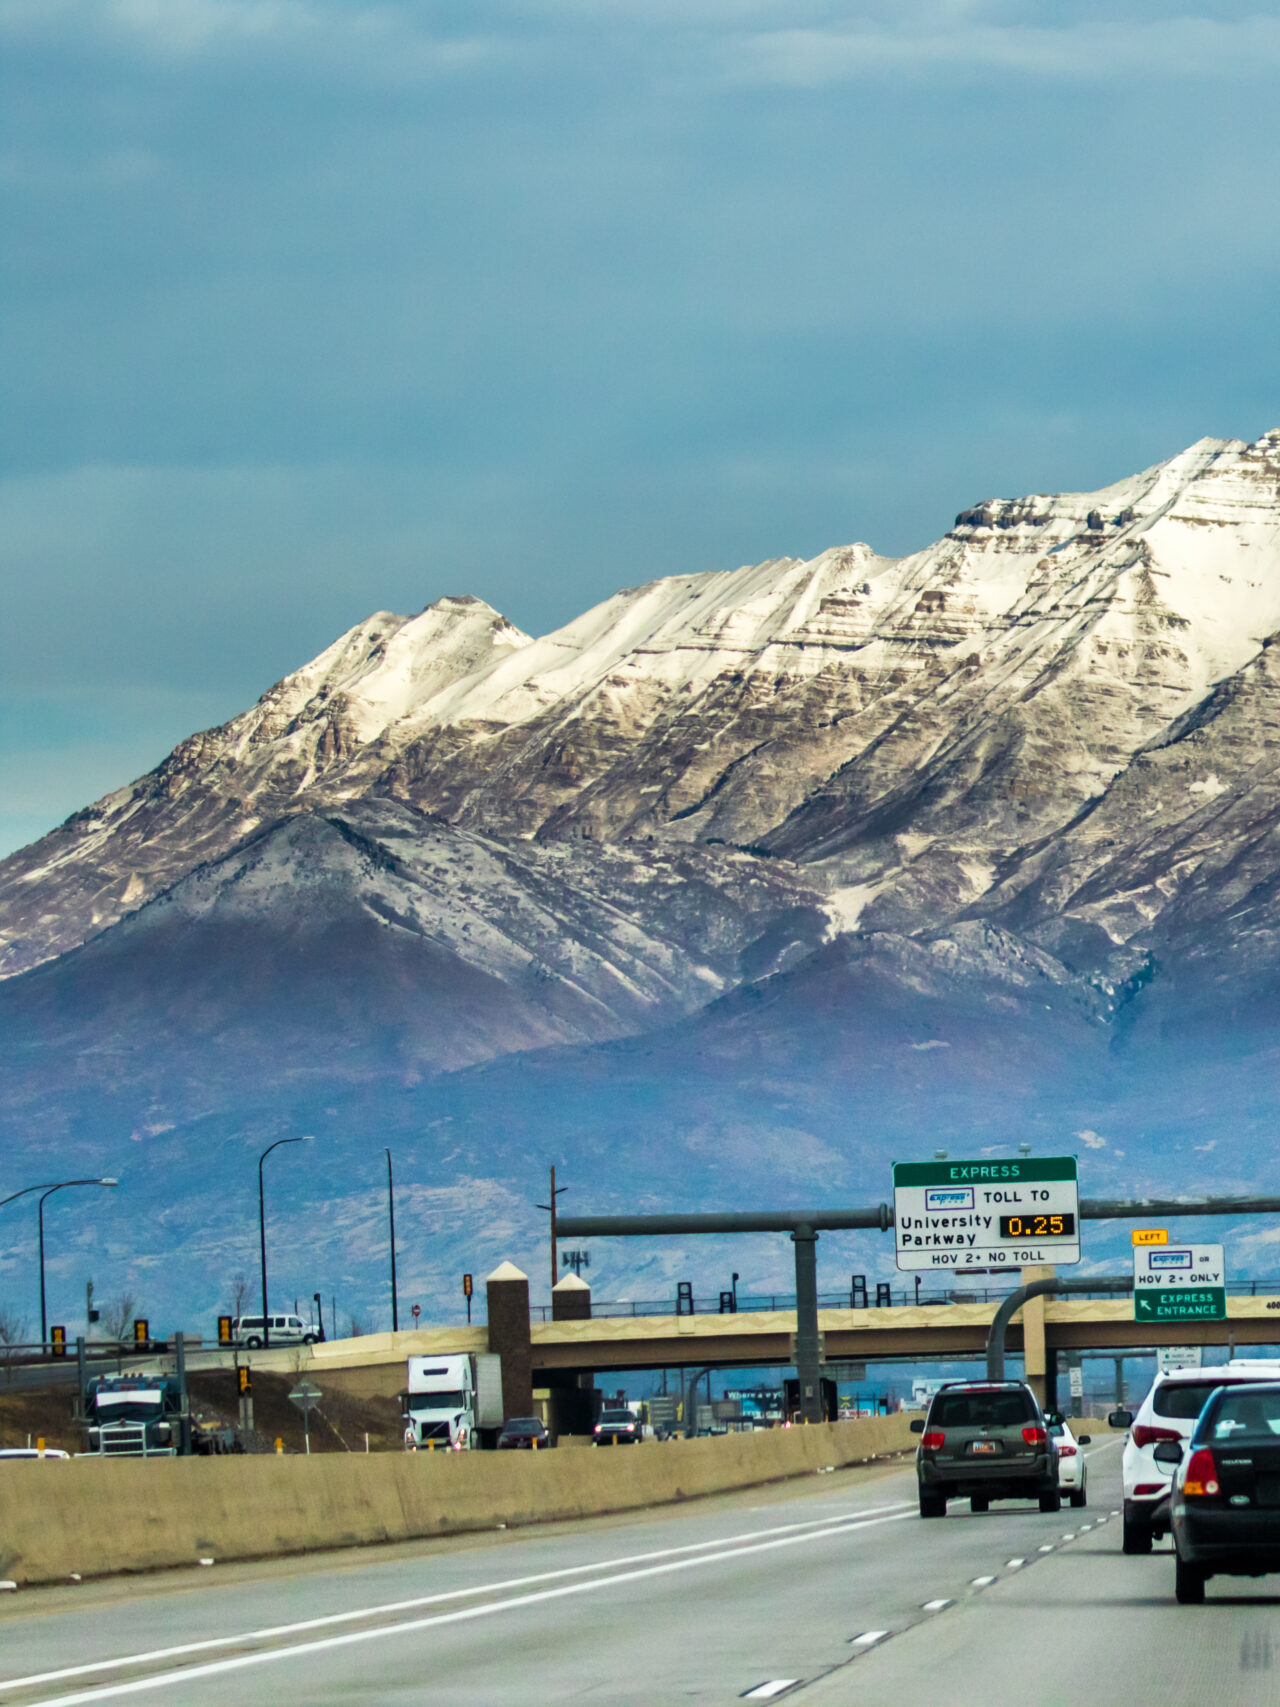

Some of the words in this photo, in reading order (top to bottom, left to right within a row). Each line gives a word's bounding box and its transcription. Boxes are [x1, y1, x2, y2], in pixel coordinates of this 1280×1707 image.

[951, 1165, 1020, 1179] EXPRESS
[984, 1191, 1022, 1203] TOLL
[1031, 1190, 1050, 1200] TO
[901, 1214, 992, 1229] University
[1009, 1216, 1064, 1236] 0.25
[902, 1233, 976, 1247] Parkway
[1139, 1233, 1161, 1241] LEFT
[932, 1254, 958, 1264] HOV
[966, 1253, 981, 1263] 2+
[989, 1252, 1006, 1262] NO
[1013, 1251, 1045, 1261] TOLL
[1139, 1275, 1161, 1284] HOV
[1190, 1273, 1219, 1282] ONLY
[1160, 1293, 1214, 1303] EXPRESS
[1157, 1305, 1217, 1315] ENTRANCE
[1266, 1301, 1280, 1310] 400
